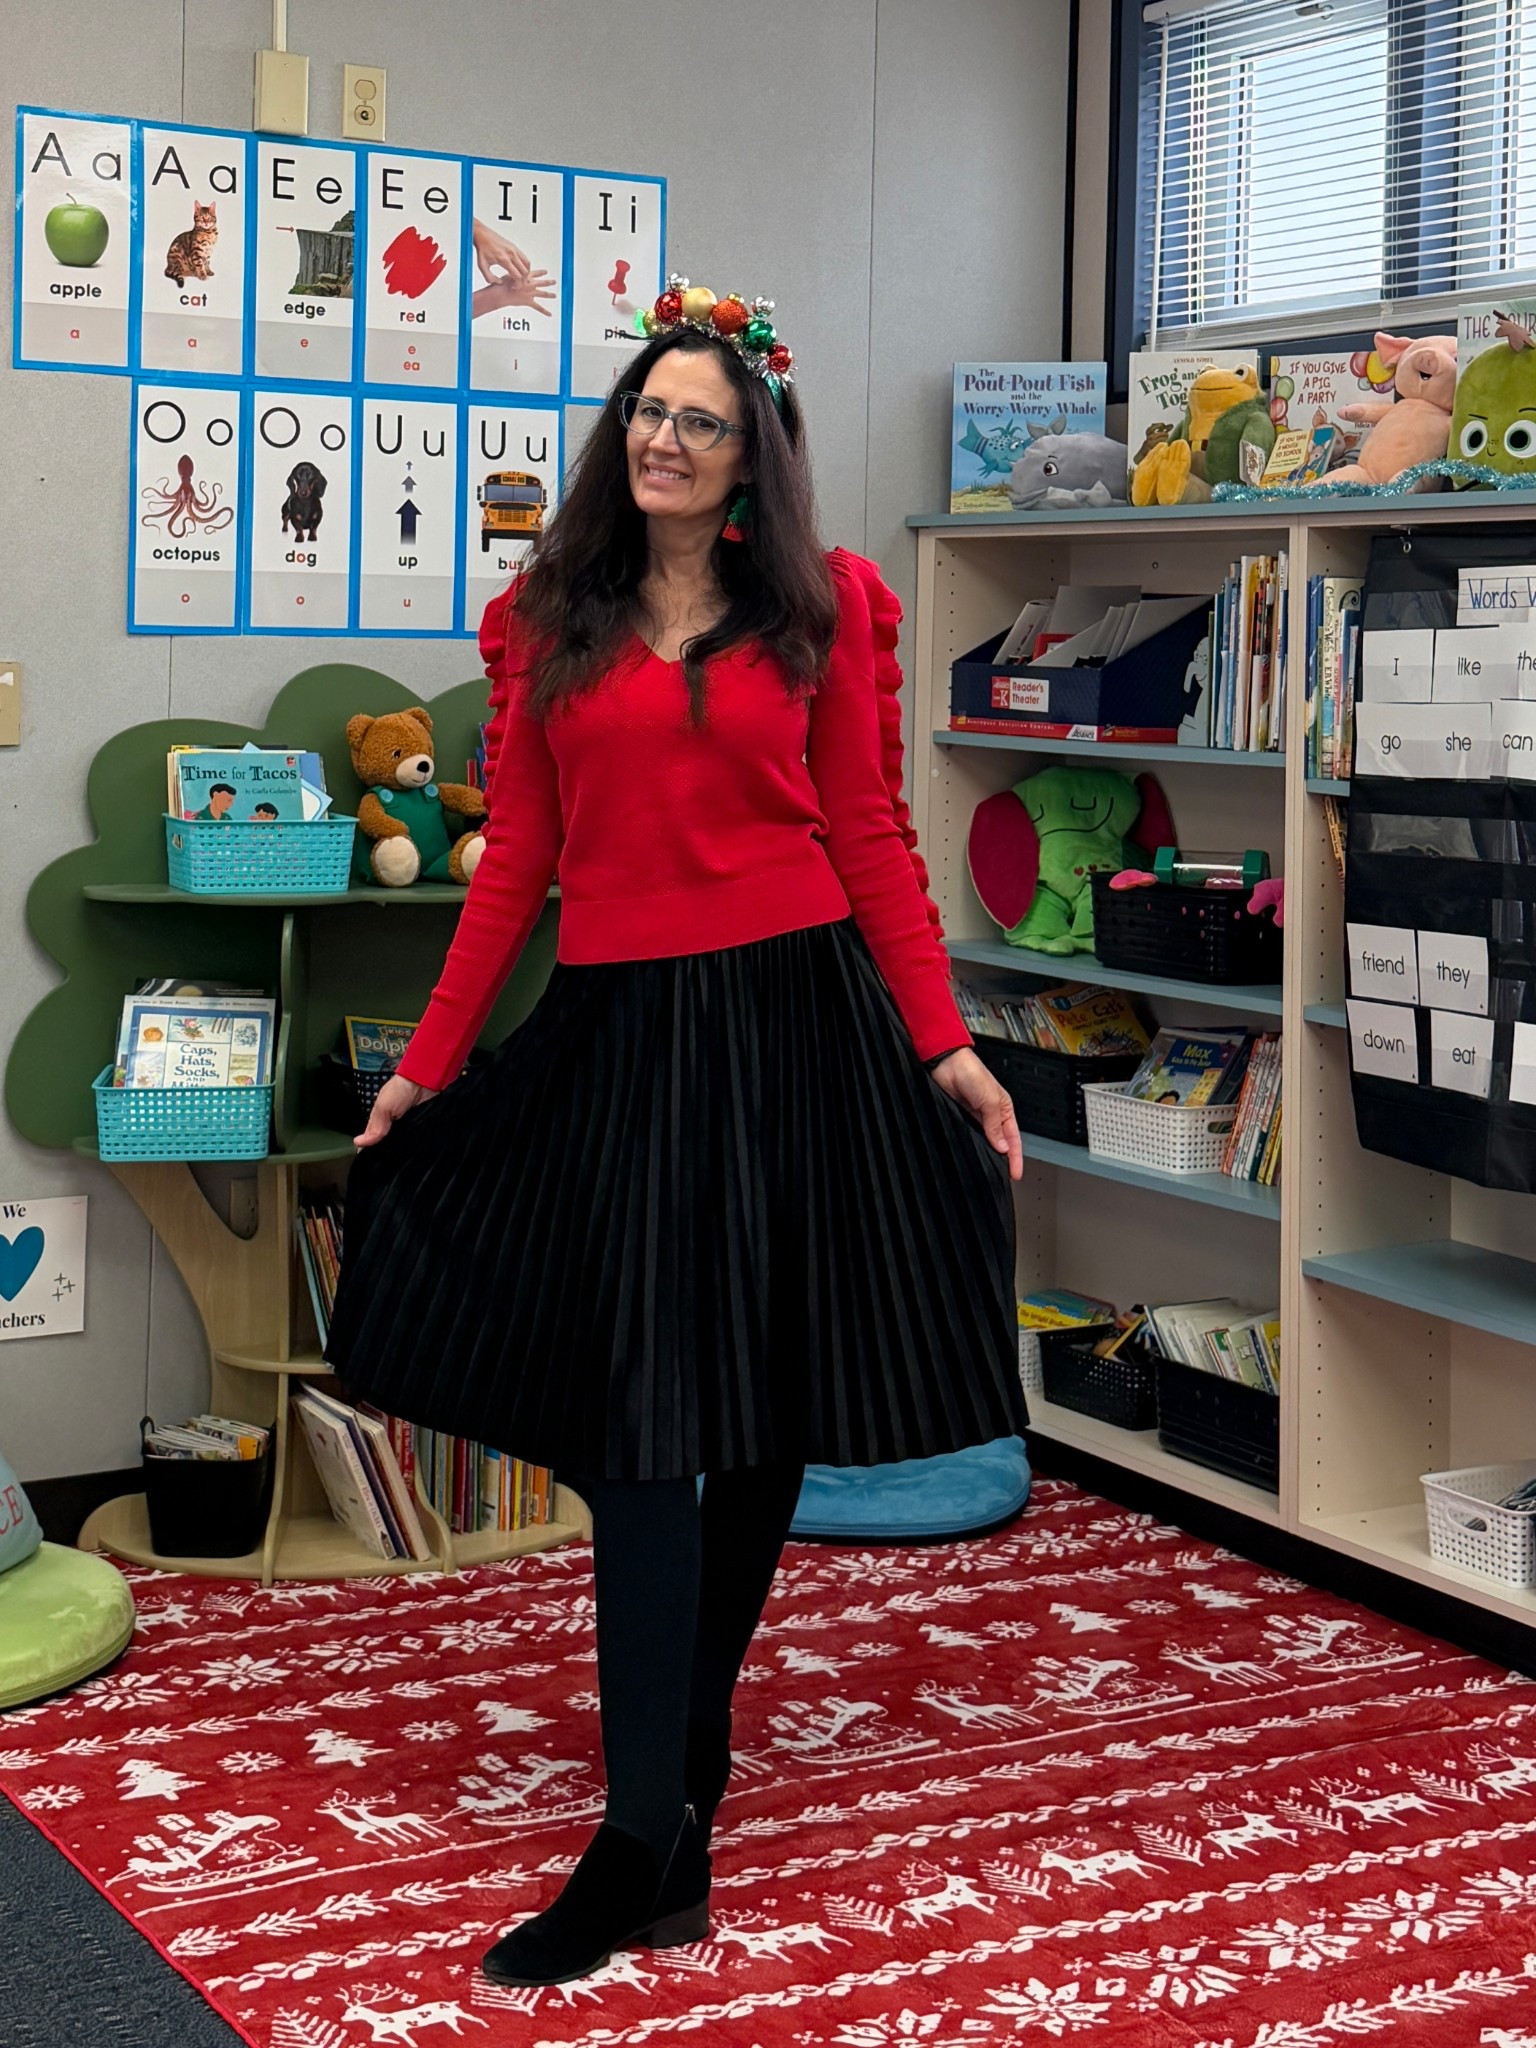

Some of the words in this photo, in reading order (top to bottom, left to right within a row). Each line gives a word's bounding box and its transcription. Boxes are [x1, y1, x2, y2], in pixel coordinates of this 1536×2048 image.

[50, 283, 102, 299] apple
[179, 293, 208, 307] cat
[284, 302, 326, 320] edge
[400, 310, 426, 324] red
[502, 316, 531, 332] itch
[1464, 315, 1490, 340] THE
[70, 329, 80, 339] a
[187, 338, 197, 348] a
[300, 339, 309, 348] e
[408, 345, 416, 355] e
[403, 361, 420, 372] ea
[978, 368, 995, 378] The
[1289, 362, 1300, 376] IF
[1302, 361, 1322, 375] YOU
[1322, 361, 1347, 375] GIVE
[963, 374, 1053, 393] Pout-Pout
[1059, 373, 1096, 393] Fish
[1137, 367, 1182, 396] Frog
[1303, 377, 1310, 390] A
[1311, 376, 1331, 389] PIG
[1010, 393, 1027, 401] and
[1028, 392, 1042, 401] the
[1297, 393, 1304, 405] A
[1305, 391, 1336, 404] PARTY
[963, 402, 1052, 418] Worry-Worry
[1057, 402, 1097, 415] Whale
[152, 546, 221, 564] octopus
[285, 550, 317, 568] dog
[398, 555, 418, 570] up
[181, 594, 190, 603] o
[1467, 577, 1517, 609] Words
[296, 596, 305, 605] o
[403, 597, 411, 607] u
[1392, 658, 1400, 676] I
[1457, 656, 1482, 676] like
[1012, 681, 1044, 693] Reader's
[1012, 693, 1040, 705] Theater
[1381, 734, 1402, 755] go
[1445, 731, 1472, 751] she
[1502, 733, 1533, 752] can
[181, 765, 227, 781] Time
[232, 767, 246, 780] for
[249, 765, 298, 781] Tacos
[1362, 951, 1406, 976] friend
[1436, 961, 1470, 990] they
[180, 1043, 217, 1056] Caps,
[1183, 1044, 1213, 1060] Max
[1363, 1029, 1406, 1054] down
[1452, 1046, 1476, 1066] eat
[180, 1055, 215, 1067] Hats,
[174, 1066, 220, 1078] Socks,
[3, 1203, 27, 1218] We
